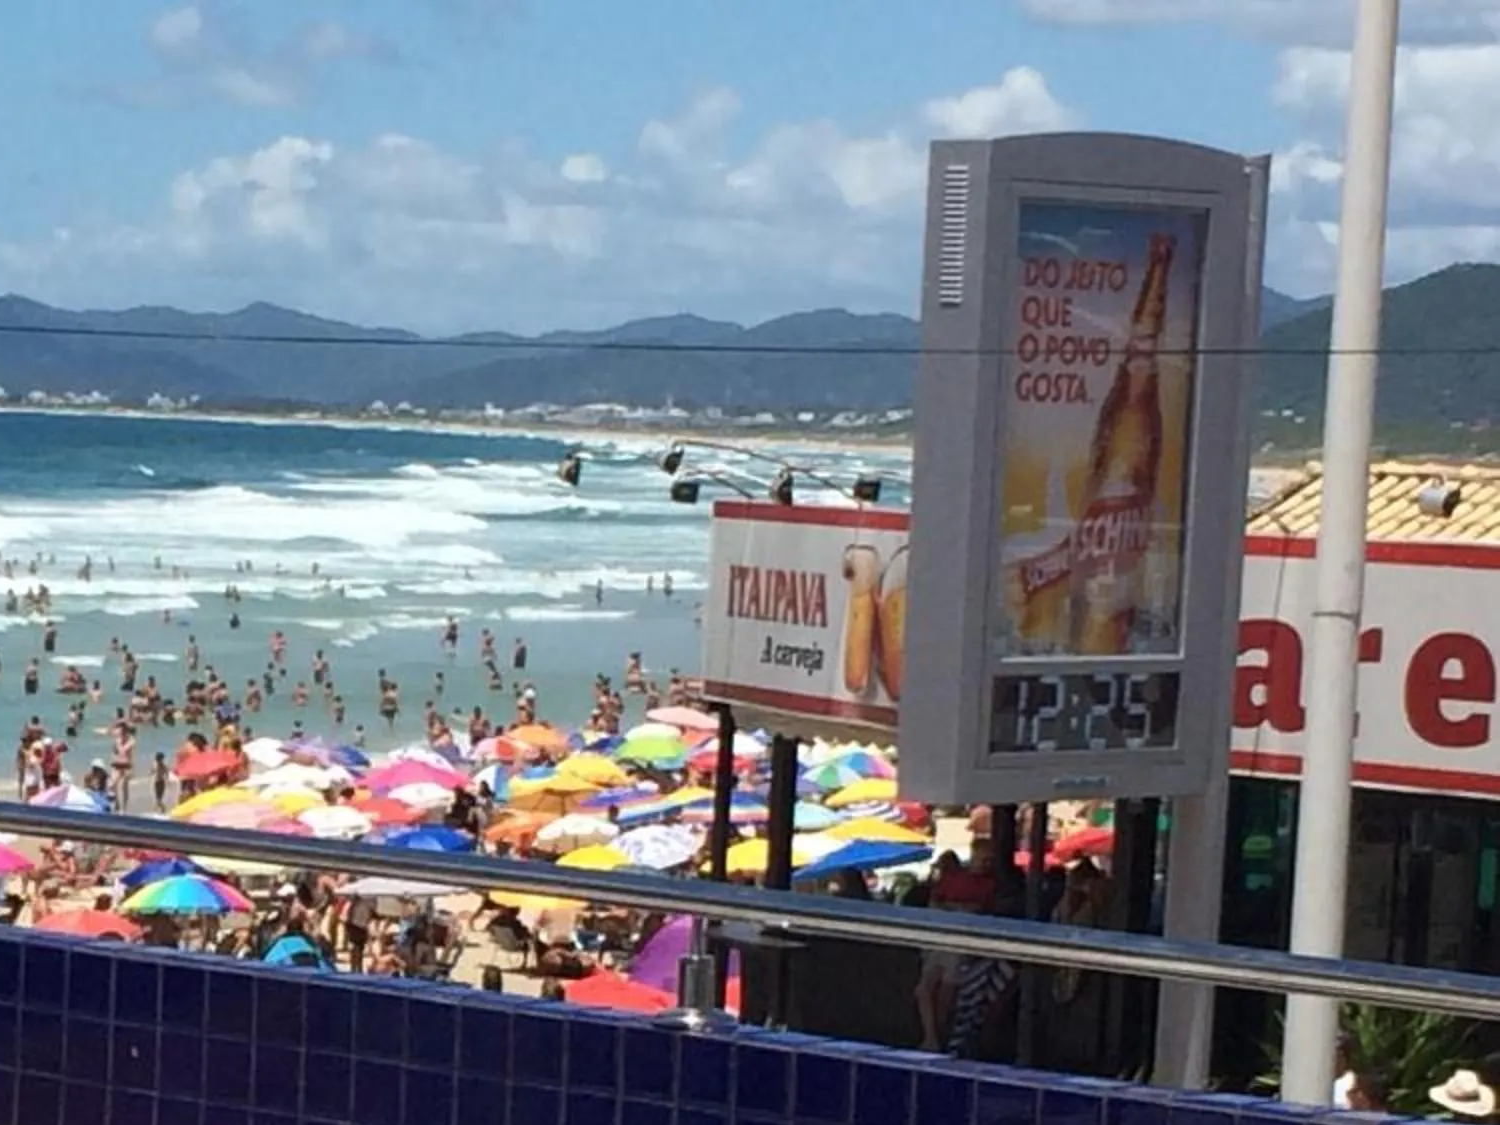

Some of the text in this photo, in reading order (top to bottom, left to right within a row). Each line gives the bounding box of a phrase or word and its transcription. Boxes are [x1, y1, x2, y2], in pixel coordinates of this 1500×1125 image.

[1024, 258, 1128, 291] DO JEITO
[1022, 296, 1073, 330] QUE
[1018, 333, 1111, 367] O POVO
[727, 564, 828, 628] ITAIPAVA
[759, 635, 825, 677] A cerveja
[1016, 673, 1150, 750] 12:25
